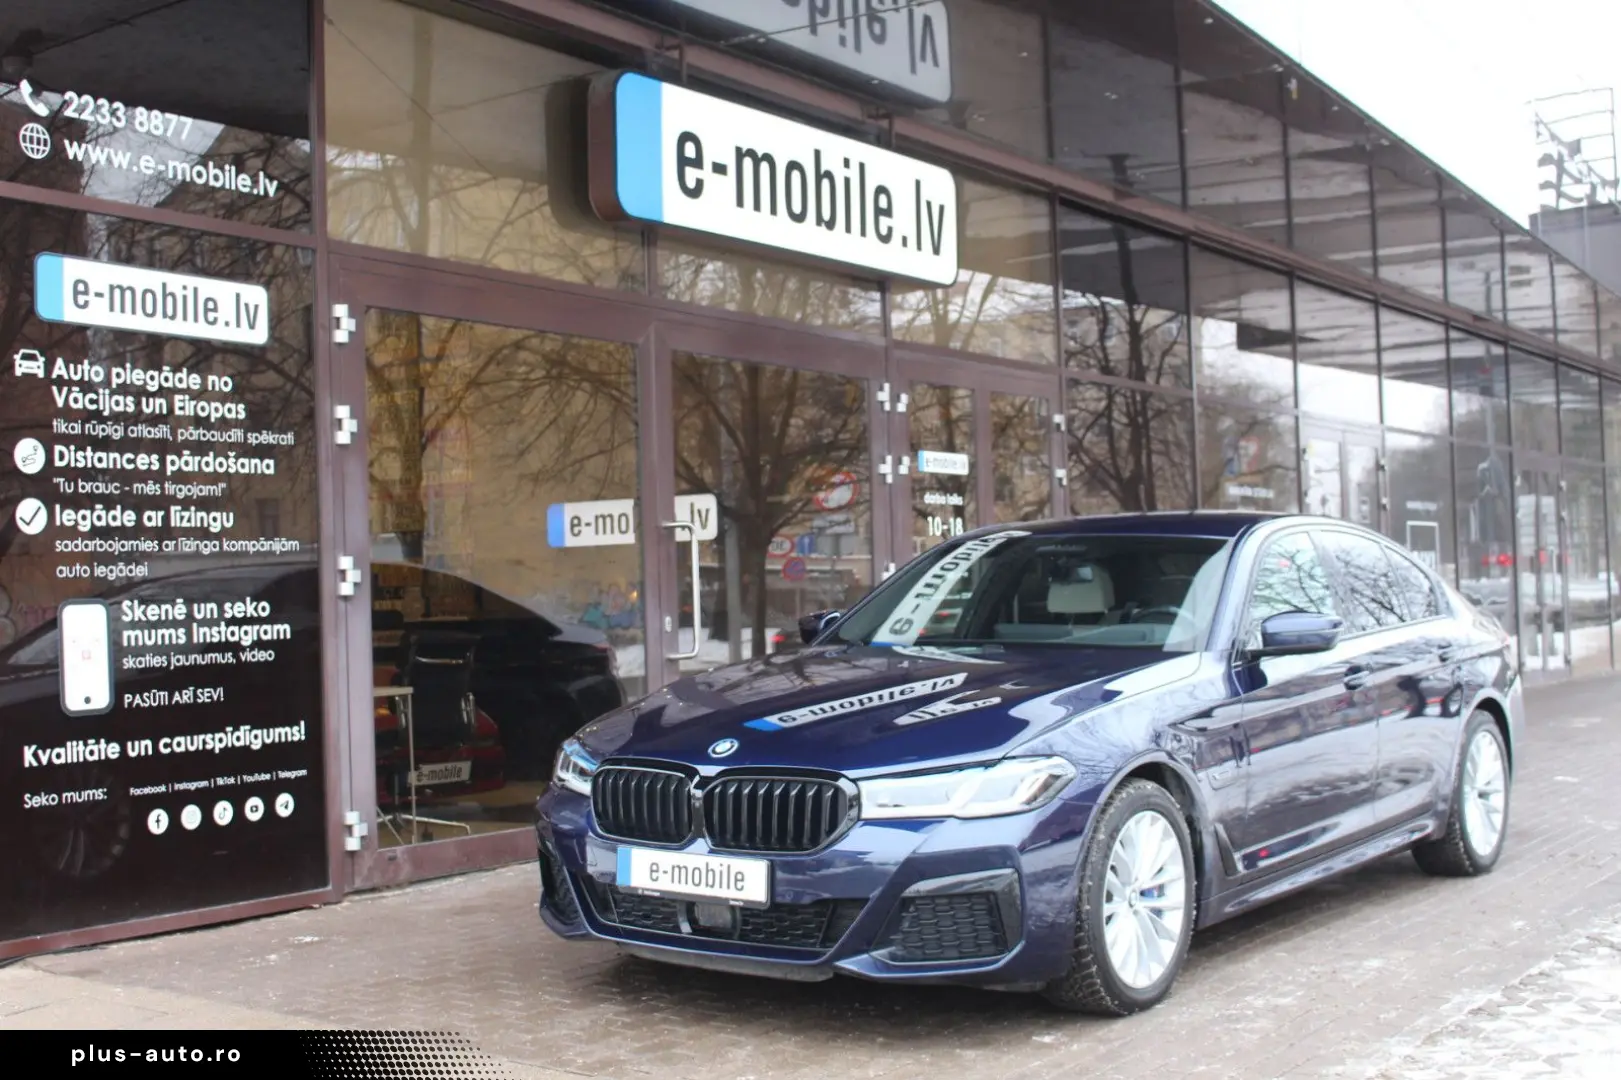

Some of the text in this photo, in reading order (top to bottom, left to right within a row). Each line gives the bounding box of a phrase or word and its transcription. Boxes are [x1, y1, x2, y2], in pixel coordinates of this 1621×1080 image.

[64, 91, 193, 140] 2233 8877
[64, 139, 279, 198] www.e-mobile.lv
[676, 130, 945, 256] e-mobile.lv
[72, 276, 260, 330] e-mobile.lv
[51, 357, 233, 392] Auto piegāde no
[52, 385, 246, 422] Vācijas un Eiropas
[52, 420, 294, 446] tikai rūpīgi atlasīti, pārbaudīti spēkrati
[54, 445, 275, 476] Distances pārdošana
[78, 479, 120, 495] brauc
[133, 480, 161, 496] mēs
[164, 481, 227, 500] tirgojam!"
[55, 504, 234, 532] Iegāde ar līzingu
[926, 516, 964, 536] 10-18
[55, 538, 300, 555] sadarbojamies ar līzinga kompānijām
[56, 562, 148, 580] auto iegādei
[121, 597, 270, 622] Skenē un seko
[122, 621, 292, 647] mums Instagram
[122, 648, 275, 670] skaties jaunumus, video
[124, 686, 224, 708] PASŪTI ARĪ SEV!
[24, 720, 306, 768] Kvalitāte un caurspīdīgums!
[129, 784, 168, 796] Facebook
[174, 780, 210, 792] Instagram
[216, 776, 236, 786] TikTok
[242, 772, 271, 784] YouTube
[278, 768, 308, 779] Telegram
[24, 788, 108, 808] Seko mums:
[649, 862, 746, 892] e-mobile
